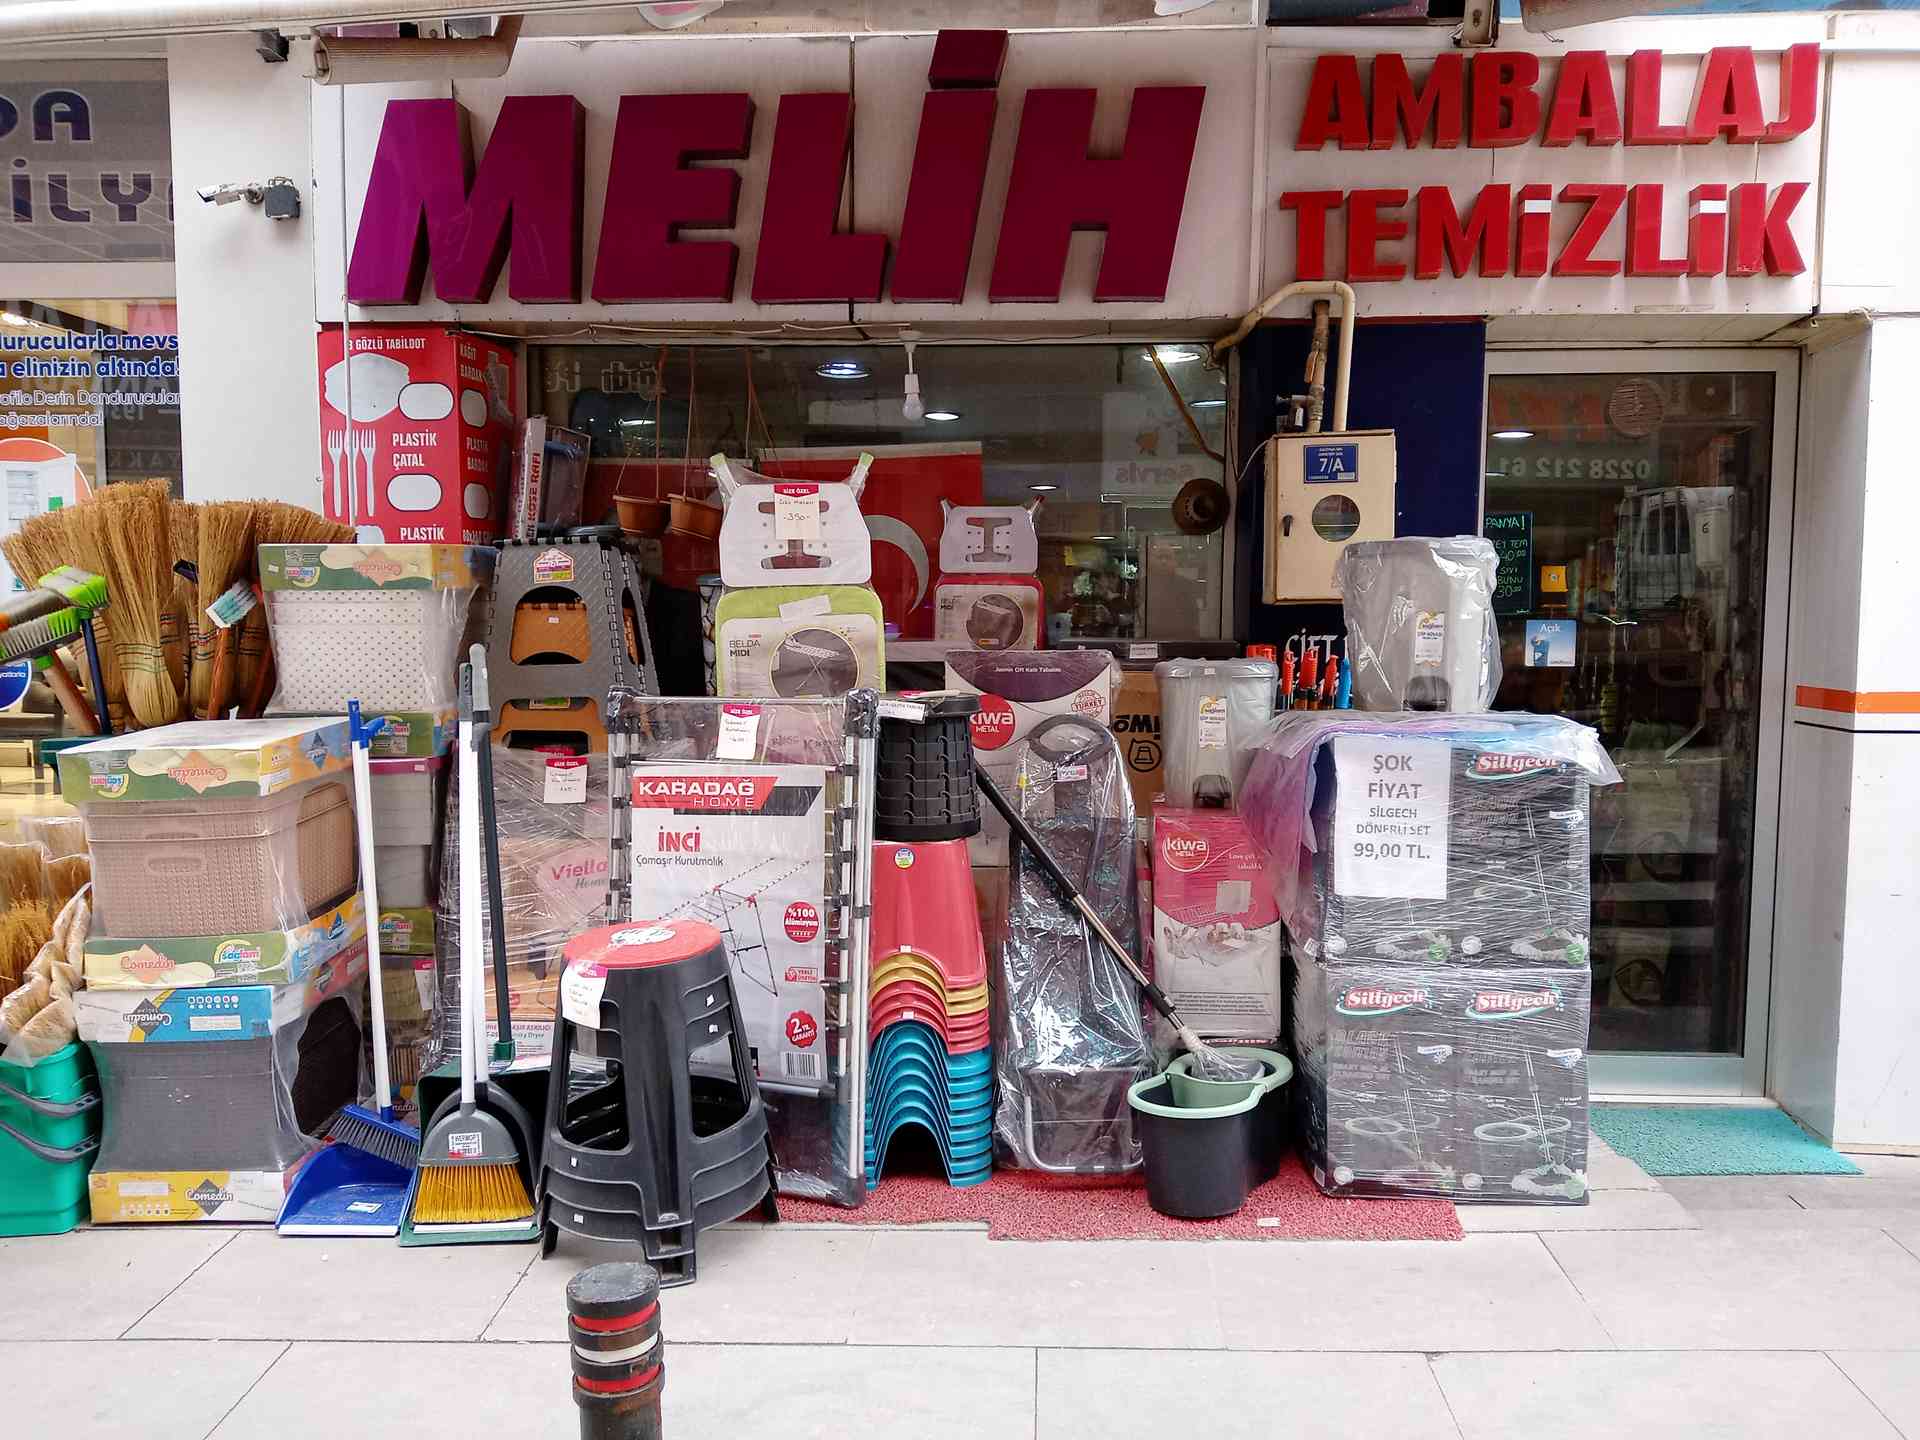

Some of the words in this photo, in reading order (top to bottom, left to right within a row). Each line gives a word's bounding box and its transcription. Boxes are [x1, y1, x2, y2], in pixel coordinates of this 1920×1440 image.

[1295, 42, 1821, 152] AMBALAJ
[346, 29, 1207, 304] MELİH
[1280, 182, 1811, 282] TEMİZLİK
[356, 336, 383, 350] GÖZLÜ
[386, 335, 426, 350] TABİLDOT
[12, 357, 91, 377] elinizin
[34, 390, 75, 406] Derin
[392, 429, 438, 447] PLASTİK
[393, 453, 425, 470] ÇATAL
[1319, 456, 1345, 473] 7/A
[400, 524, 445, 541] PLASTİK
[729, 639, 761, 648] BELDA
[1373, 754, 1413, 774] ŞOK
[639, 778, 755, 796] KARADAĞ
[1368, 779, 1423, 799] FİYAT
[693, 797, 754, 807] HOME
[1369, 805, 1417, 818] SİLGECH
[1410, 825, 1431, 835] SET
[658, 826, 702, 852] İNCİ
[1167, 838, 1207, 850] kiwa
[1354, 843, 1401, 860] 99,00
[1406, 844, 1430, 859] TL.
[636, 855, 673, 867] Çamaşır
[674, 855, 724, 866] Kurutmalık
[788, 908, 816, 918] %100
[120, 952, 176, 972] Comedin
[791, 1018, 802, 1034] 2
